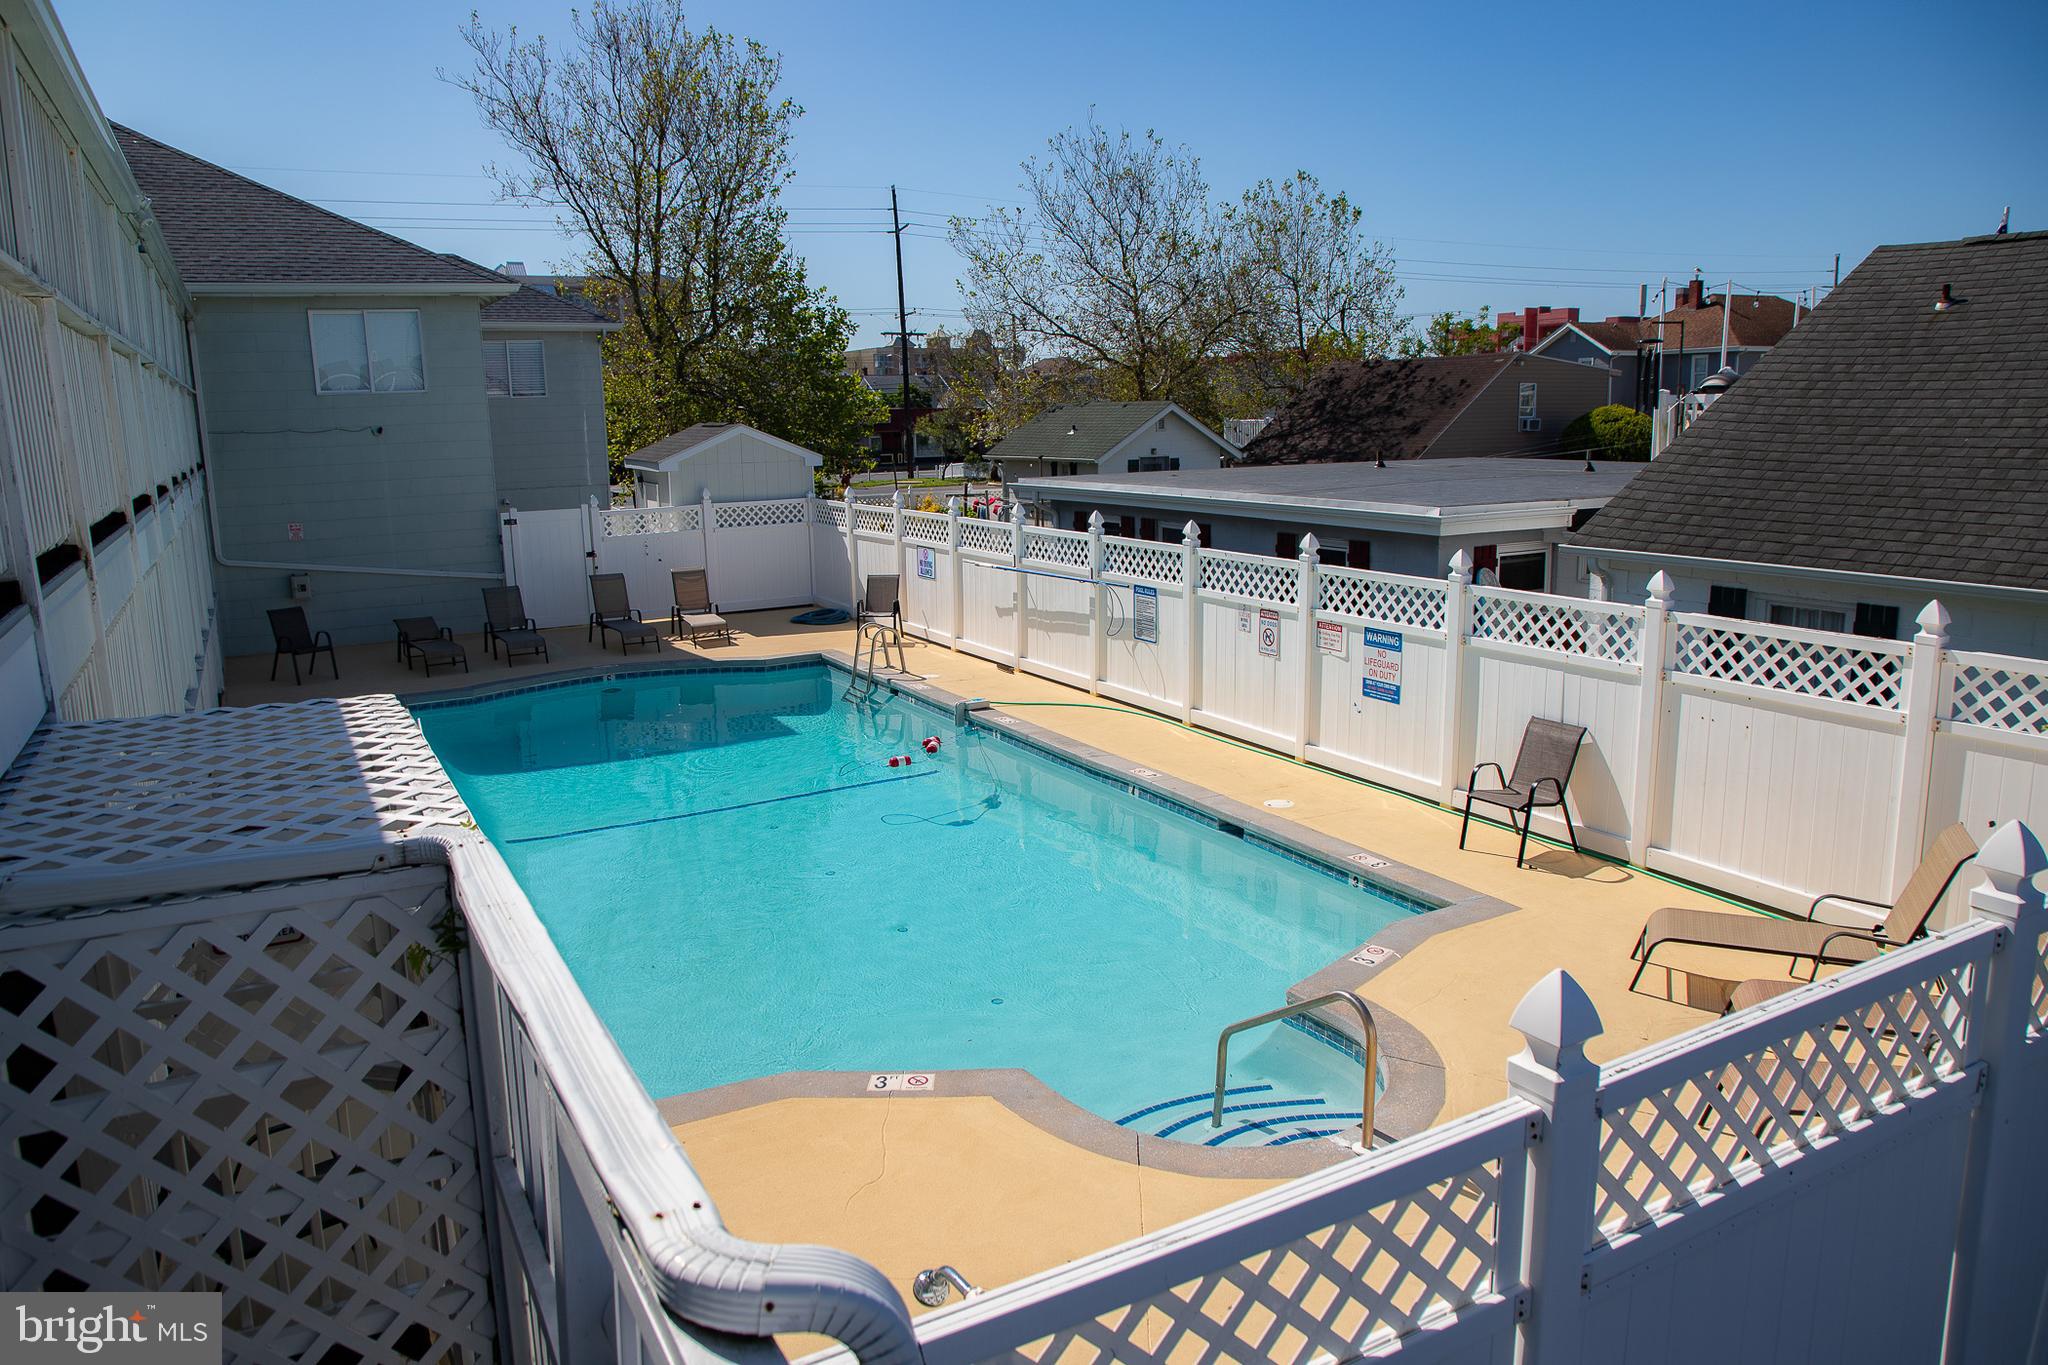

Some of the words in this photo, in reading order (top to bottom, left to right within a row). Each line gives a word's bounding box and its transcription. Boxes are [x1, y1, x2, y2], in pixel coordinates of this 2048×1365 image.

[1318, 622, 1342, 632] ATTENTION
[1366, 631, 1400, 647] WARNING
[1377, 649, 1387, 658] NO
[1364, 656, 1400, 672] LIFEGUARD
[1368, 668, 1378, 677] ON
[1379, 670, 1397, 681] DUTY
[1353, 956, 1376, 965] 3
[874, 1075, 888, 1089] 3
